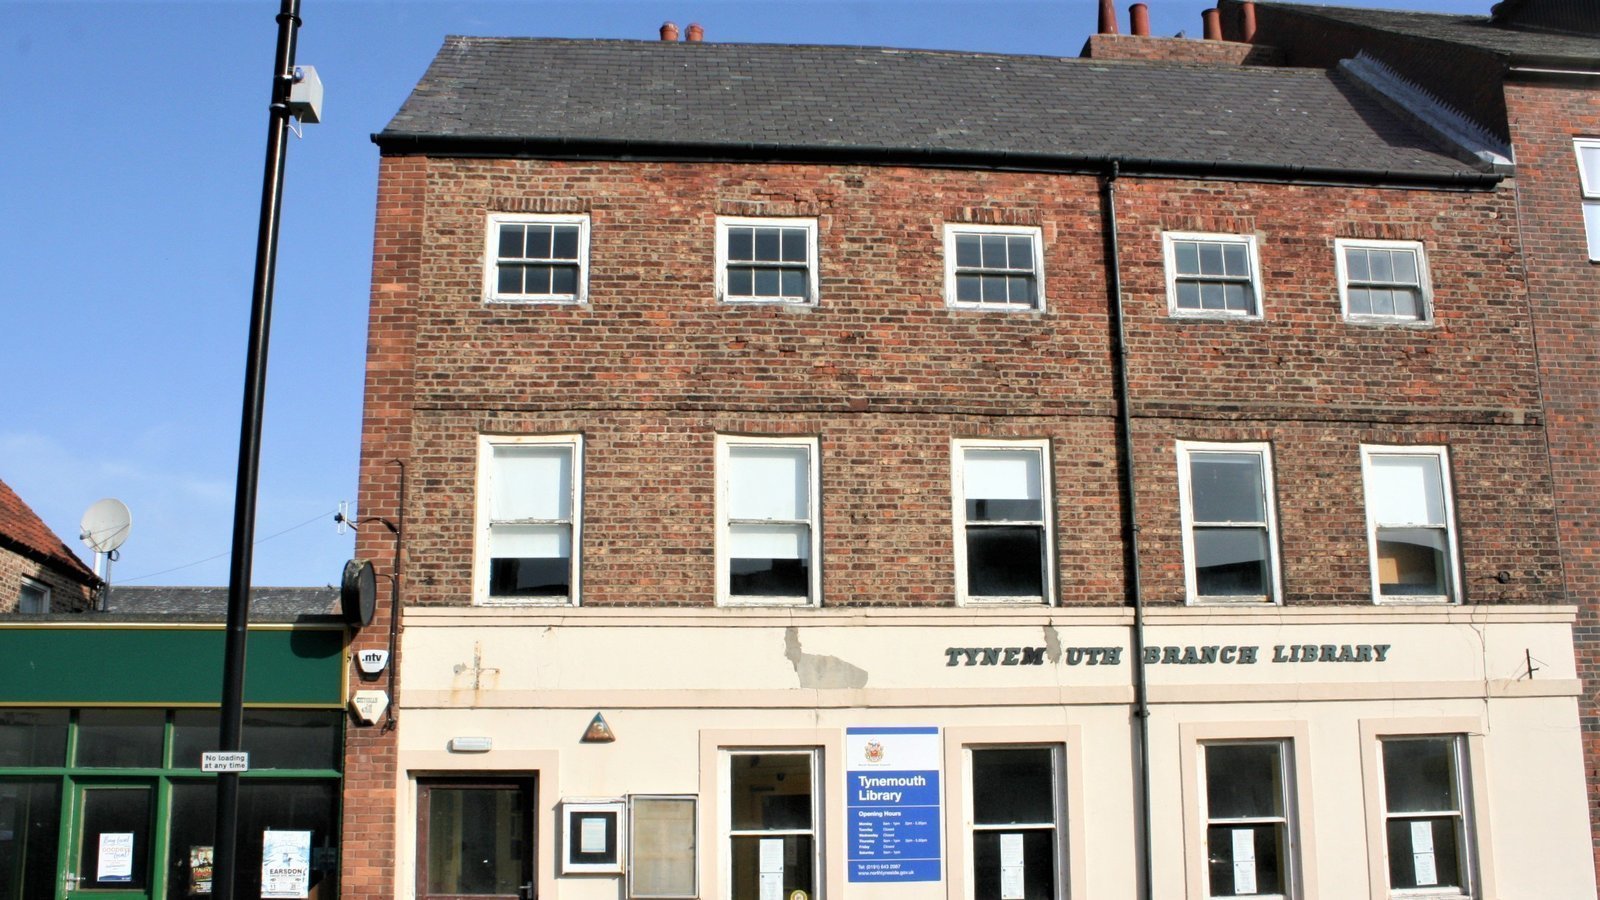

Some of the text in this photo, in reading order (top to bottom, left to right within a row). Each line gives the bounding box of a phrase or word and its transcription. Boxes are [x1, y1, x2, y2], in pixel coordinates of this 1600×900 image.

[1143, 646, 1259, 664] BRANCH
[1272, 644, 1391, 663] LIBRARY
[858, 776, 926, 788] Tynemouth
[859, 790, 902, 802] Library
